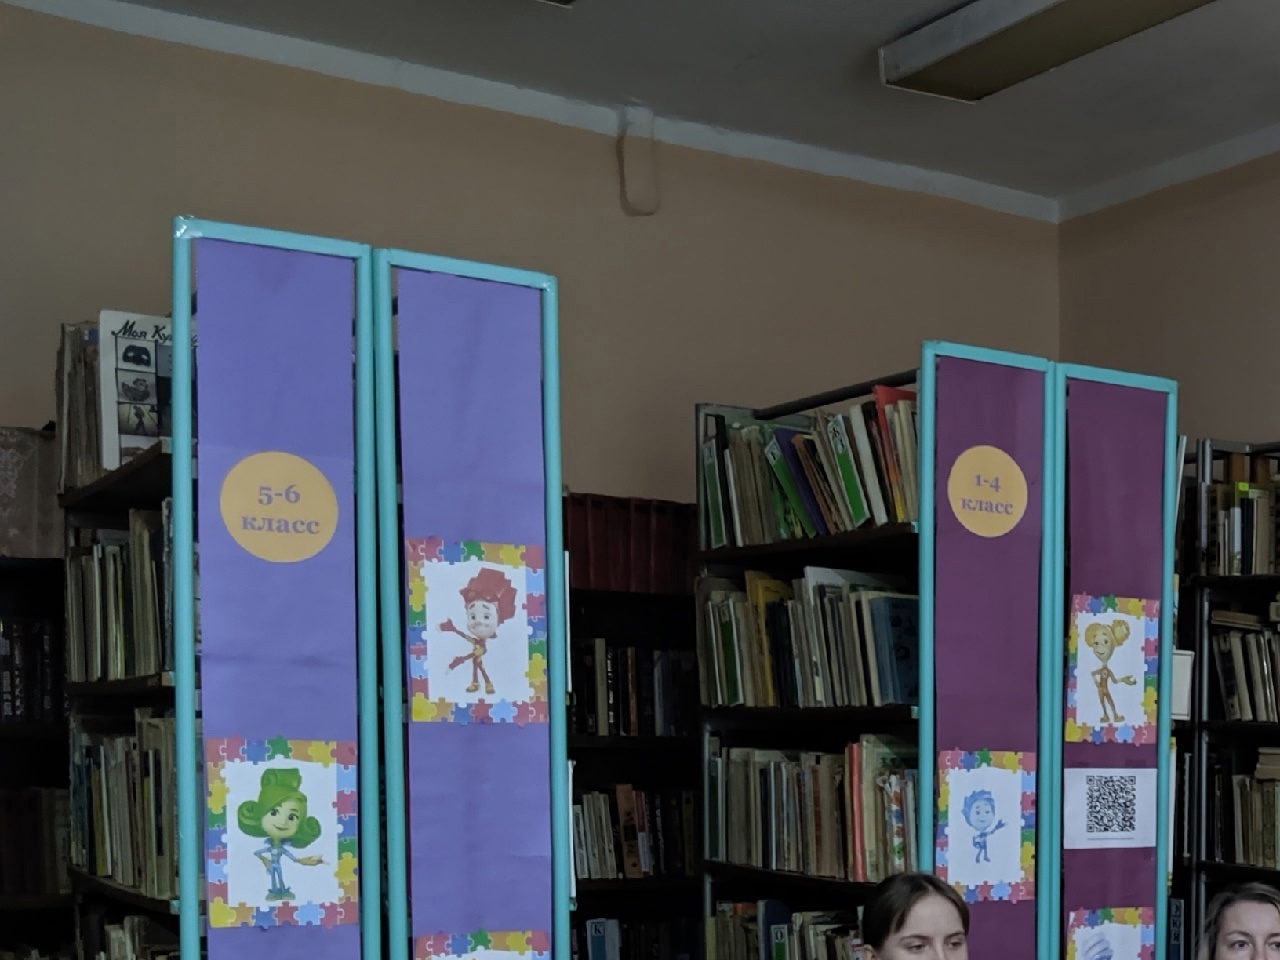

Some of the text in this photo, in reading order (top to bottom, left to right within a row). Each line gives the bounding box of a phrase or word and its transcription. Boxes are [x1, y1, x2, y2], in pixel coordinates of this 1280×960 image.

[973, 473, 1002, 493] 1-4
[257, 483, 301, 506] 5-6
[960, 496, 1014, 516] класс
[240, 513, 321, 536] класс
